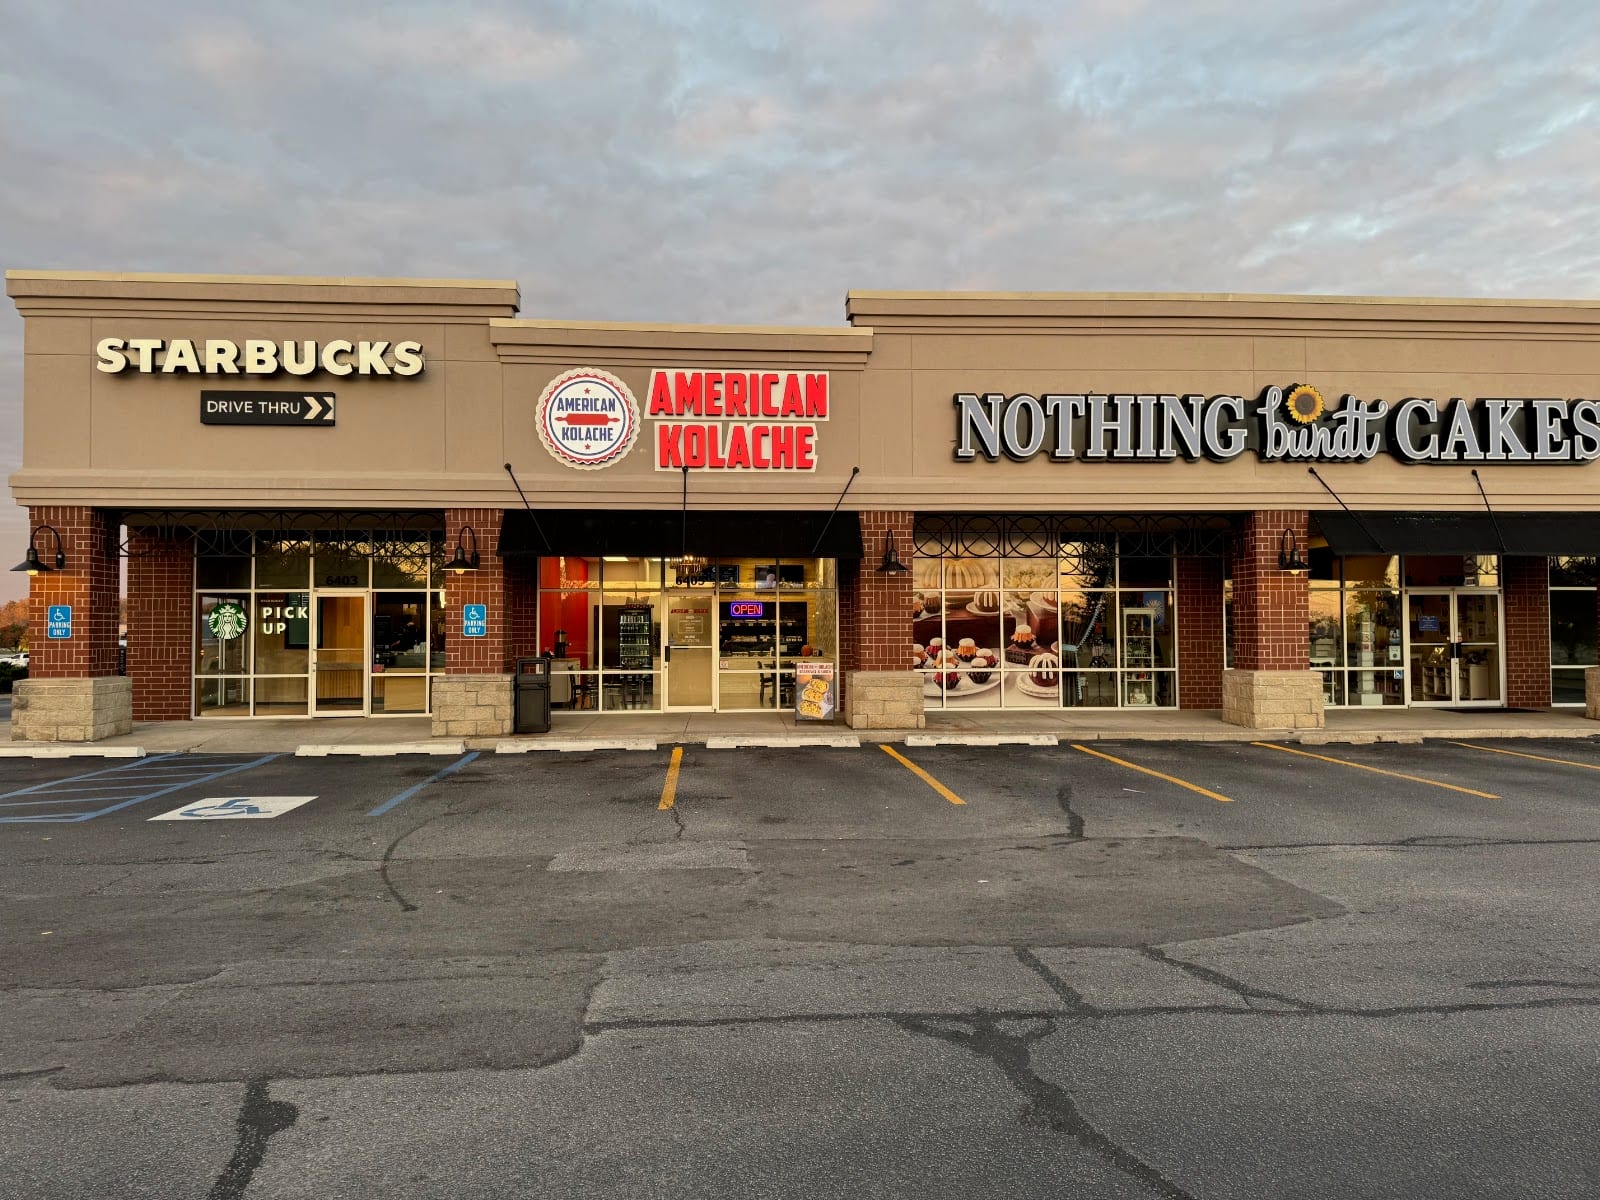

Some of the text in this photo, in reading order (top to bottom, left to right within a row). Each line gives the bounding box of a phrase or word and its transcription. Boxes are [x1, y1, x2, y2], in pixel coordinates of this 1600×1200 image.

[96, 337, 425, 376] STARBUCKS
[649, 371, 828, 418] AMERICAN
[206, 400, 301, 415] DRIVE THRU
[556, 397, 616, 412] AMERICAN
[957, 385, 1600, 460] NOTHING bundt CAKES
[561, 426, 614, 442] KOLACHE
[658, 424, 815, 470] KOLACHE
[326, 575, 358, 585] 6403
[676, 575, 705, 585] 6405
[262, 606, 309, 619] PICK
[732, 604, 761, 615] OPEN
[262, 622, 287, 635] UP
